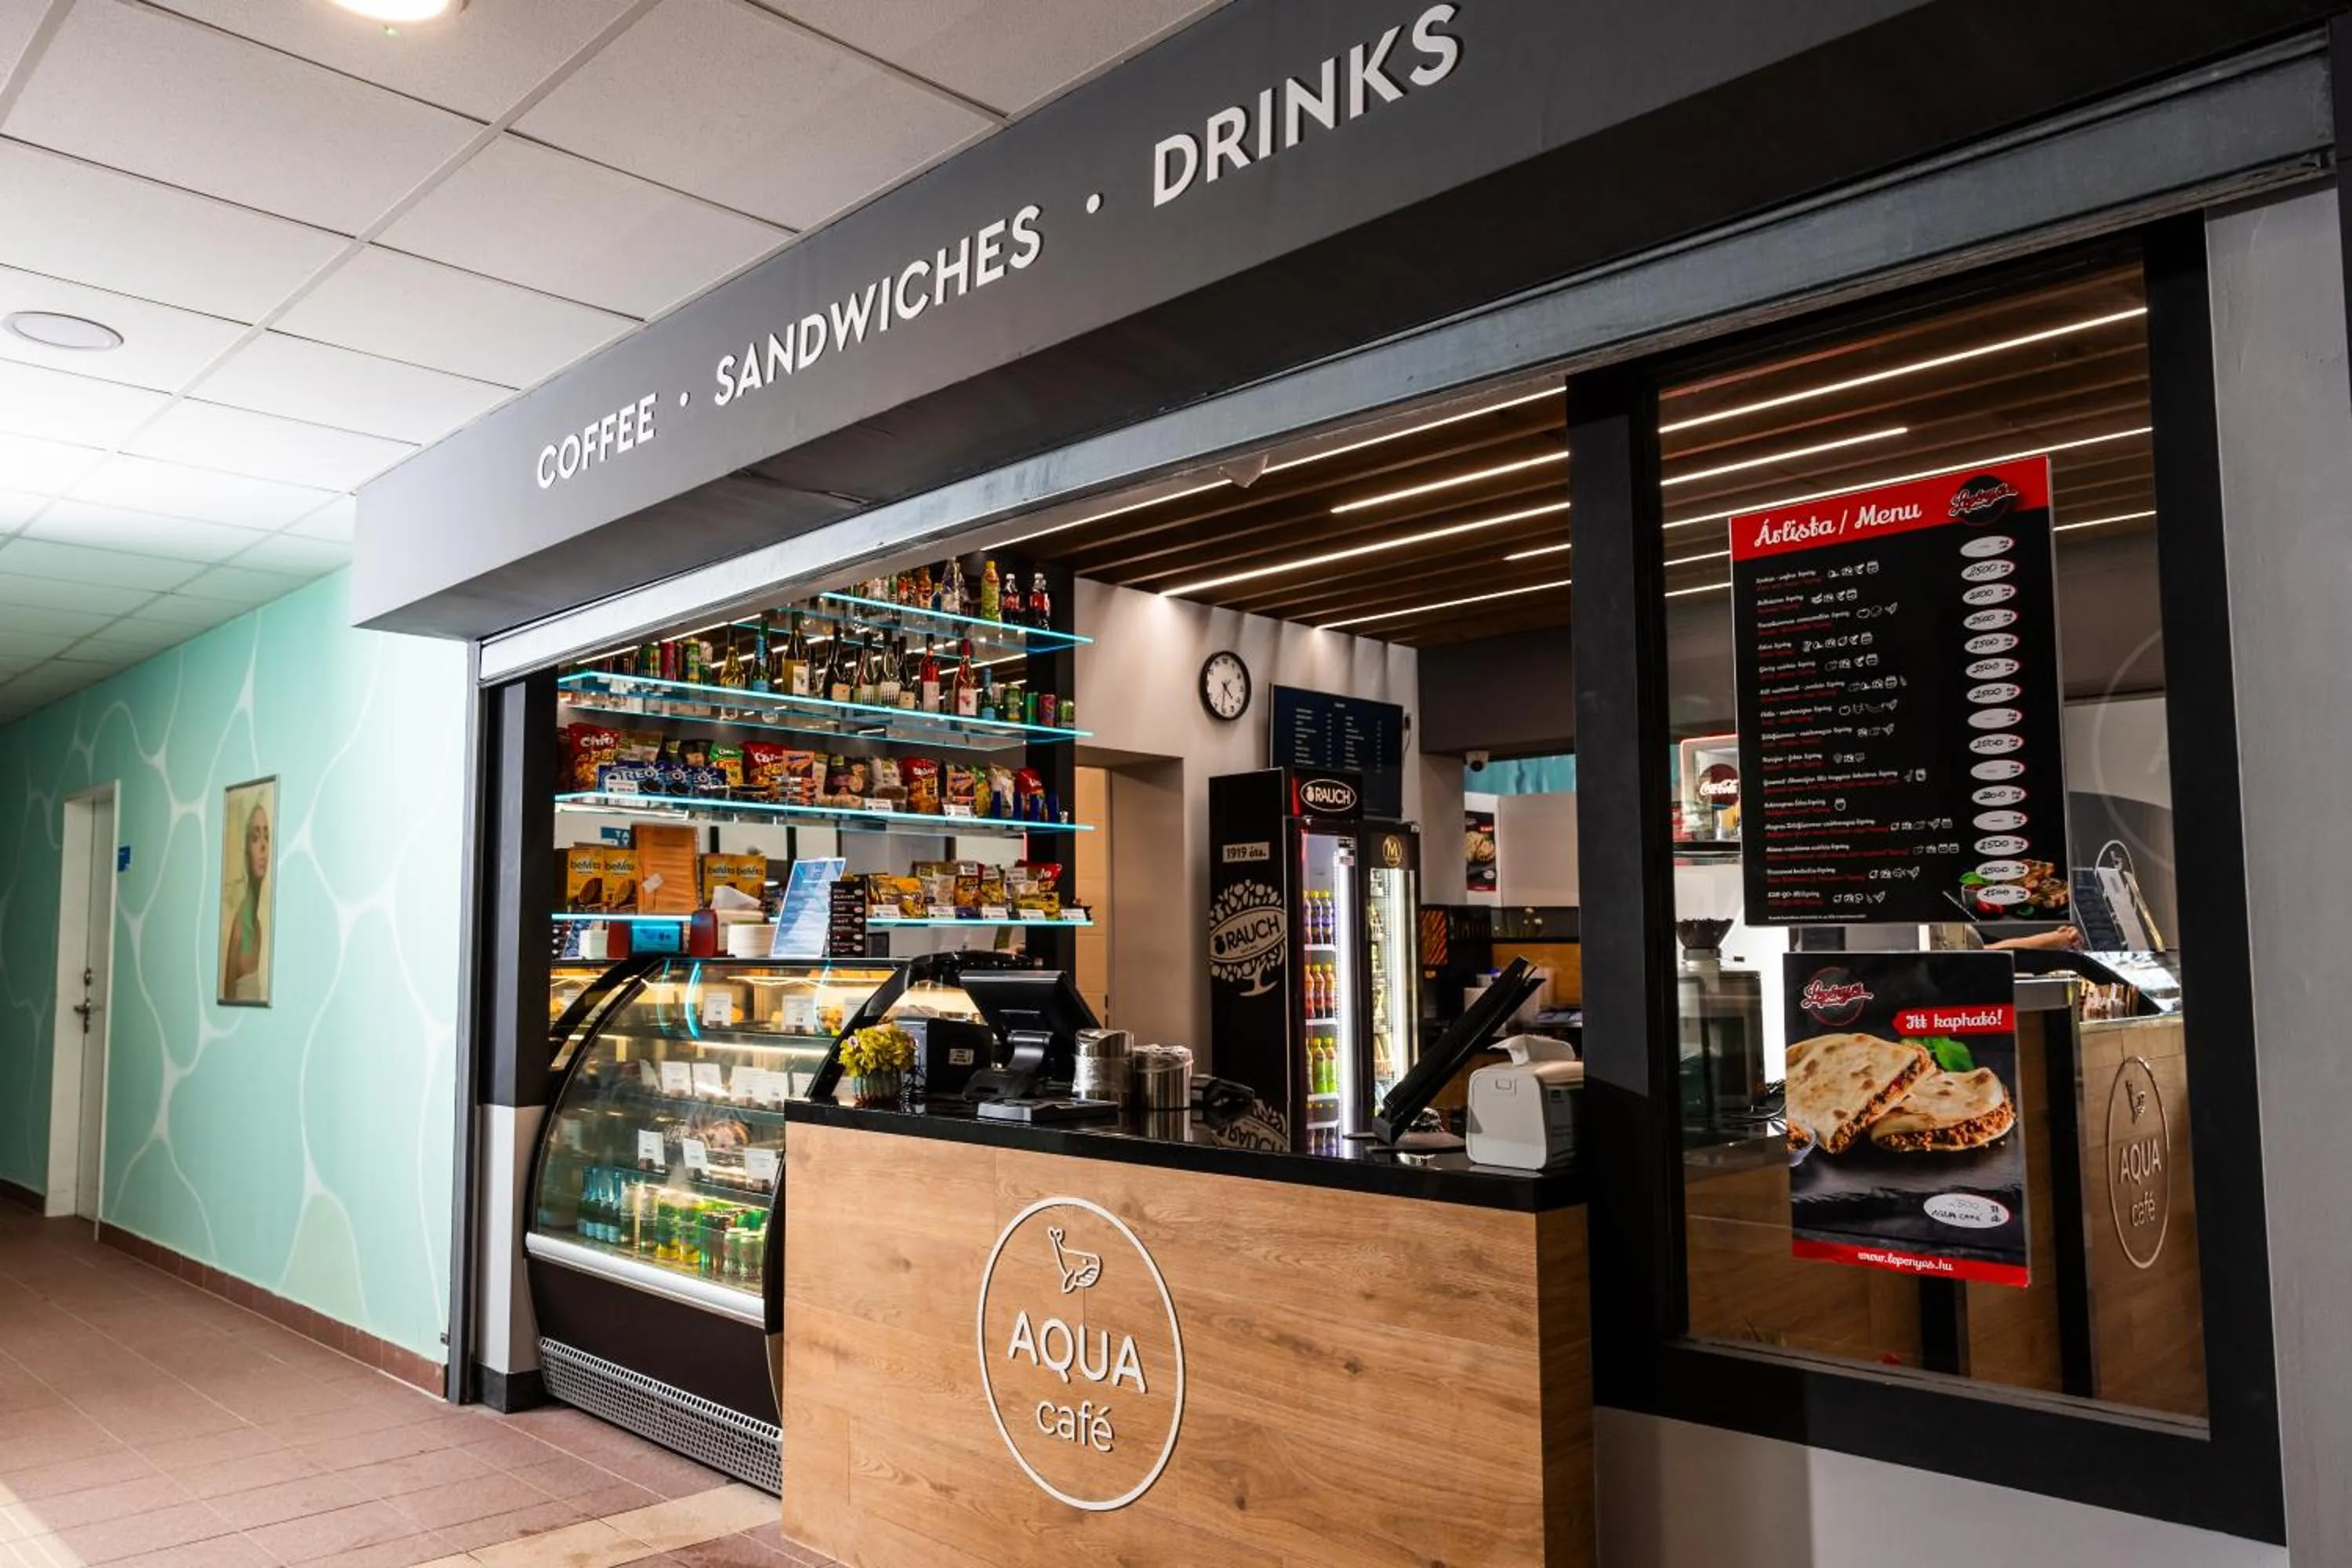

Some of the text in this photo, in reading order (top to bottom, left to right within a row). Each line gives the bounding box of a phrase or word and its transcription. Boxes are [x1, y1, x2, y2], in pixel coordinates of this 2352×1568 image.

[536, 3, 1460, 489] COFFEE SANDWICHES DRINKS
[1854, 503, 1923, 529] Menu
[1315, 786, 1351, 805] RAUCH
[1226, 848, 1247, 859] 1919
[1225, 915, 1281, 950] RAUCH
[1934, 1008, 2003, 1033] kapható!
[2119, 1138, 2161, 1186] AQUA
[2132, 1191, 2155, 1227] café
[1007, 1310, 1148, 1394] AQUA
[1035, 1399, 1114, 1452] café
